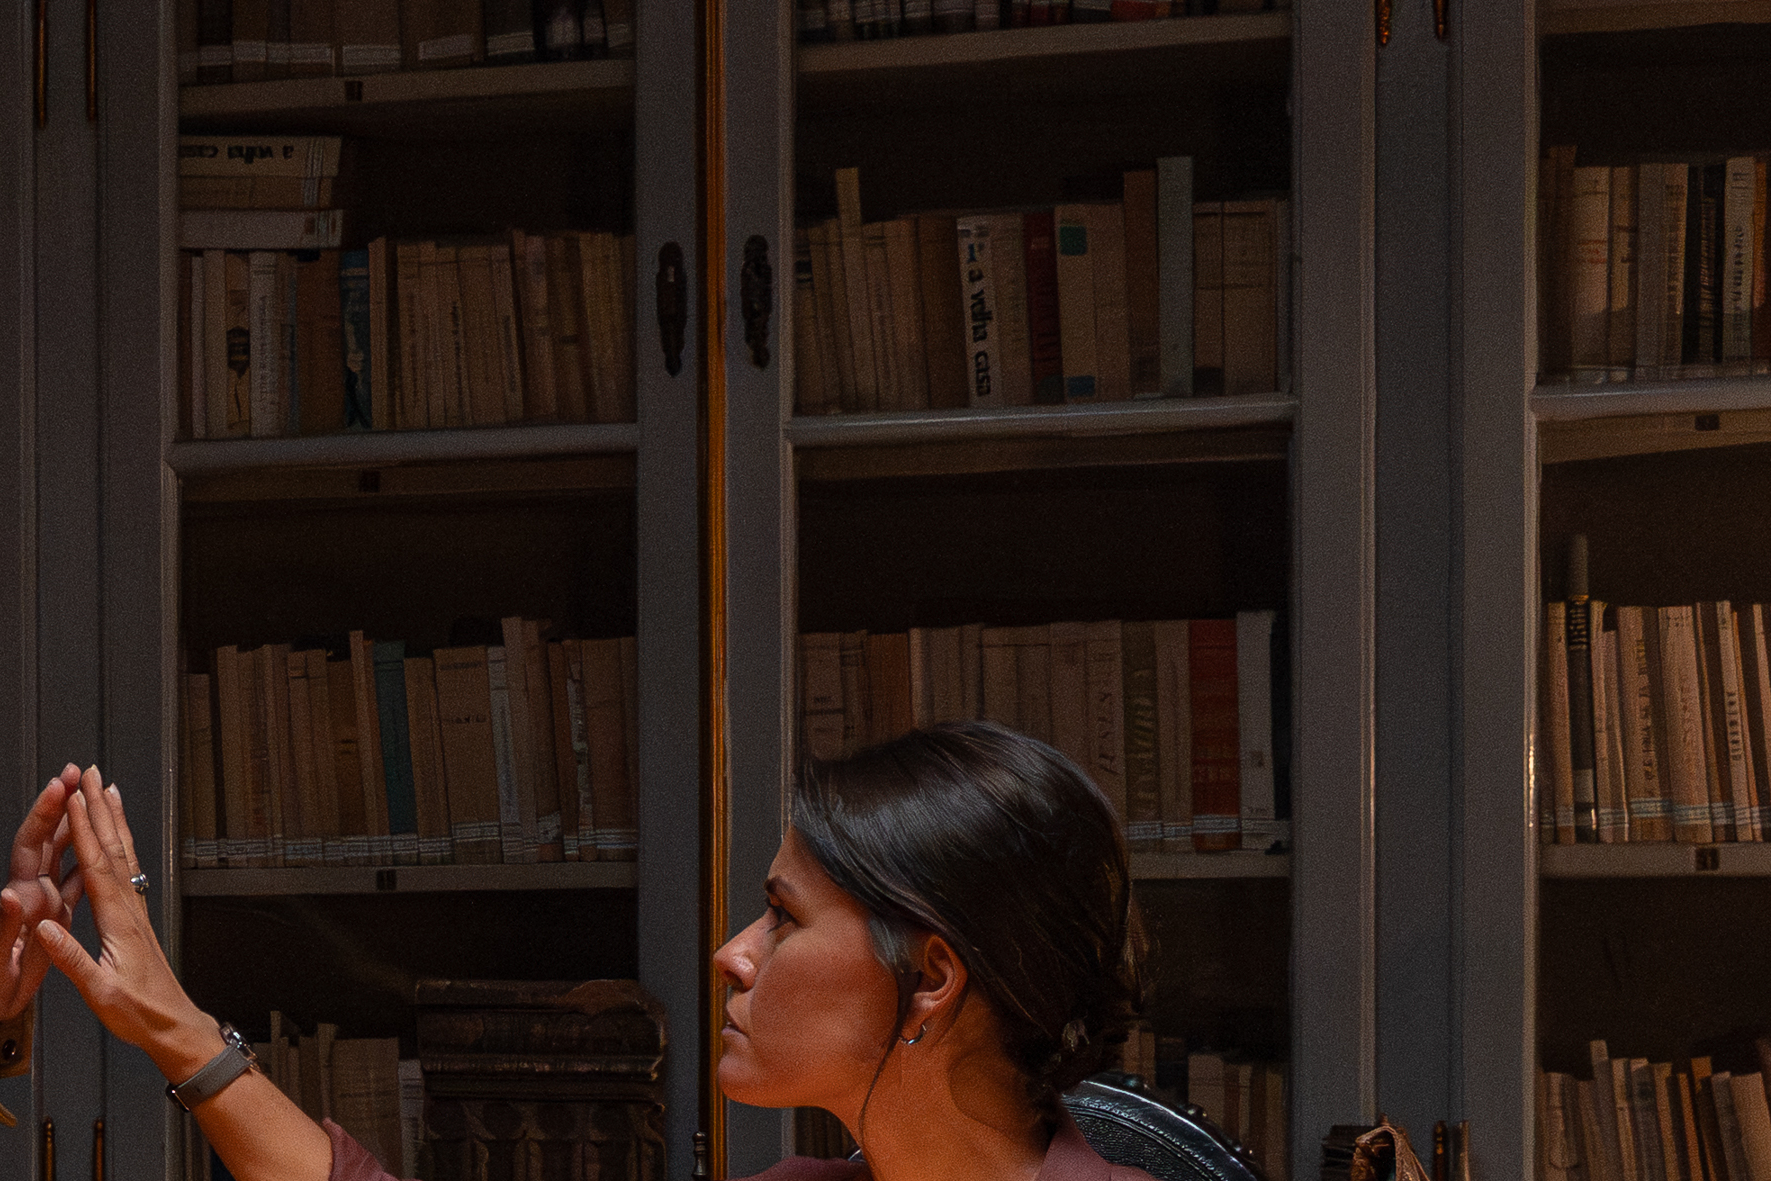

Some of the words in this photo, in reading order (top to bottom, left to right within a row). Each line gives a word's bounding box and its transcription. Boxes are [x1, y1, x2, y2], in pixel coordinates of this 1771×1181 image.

[178, 145, 219, 159] ca
[282, 145, 294, 160] a
[970, 270, 984, 284] a
[971, 289, 992, 343] velha
[975, 351, 991, 397] casa
